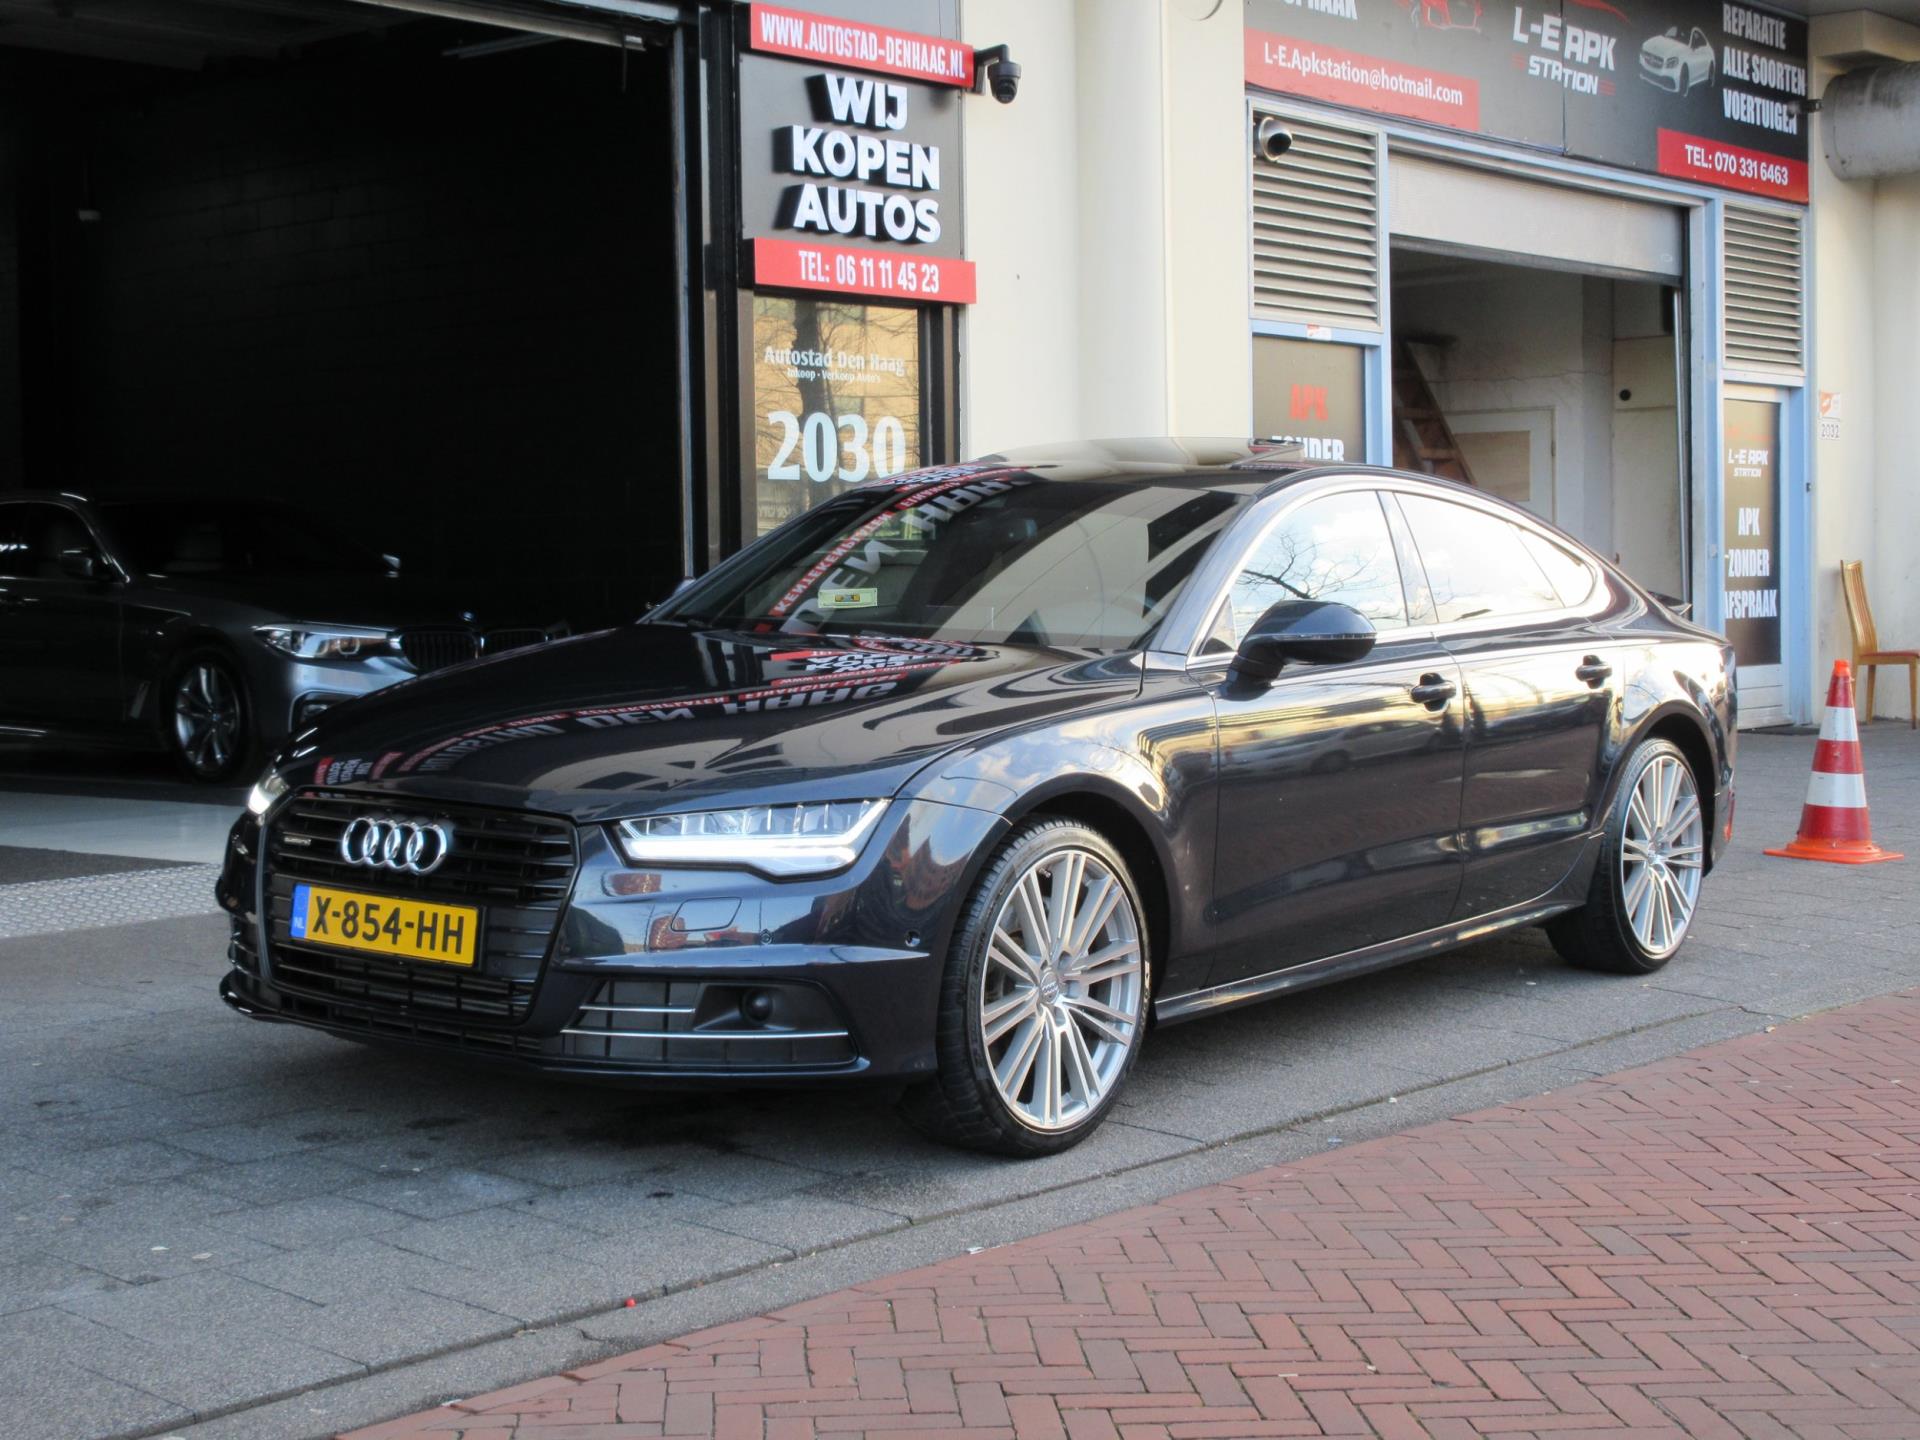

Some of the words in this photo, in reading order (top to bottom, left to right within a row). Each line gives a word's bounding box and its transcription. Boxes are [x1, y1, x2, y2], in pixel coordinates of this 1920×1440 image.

[761, 12, 966, 79] WWW.AUTOSTAD-DENHAAG.NL
[1513, 6, 1561, 51] L-E
[1564, 24, 1616, 71] APK
[1723, 4, 1786, 50] REPARATIE
[1264, 42, 1463, 105] L-E.Apkstation@hotmail.com
[1528, 54, 1598, 95] STATION
[1723, 46, 1750, 81] ALLE
[1752, 54, 1806, 97] SOORTEN
[824, 73, 908, 131] WIJ
[792, 125, 940, 190] KOPEN
[1685, 144, 1713, 169] TEL:
[1714, 155, 1737, 175] 070
[1739, 158, 1758, 180] 331
[1759, 162, 1789, 186] 6463
[793, 183, 942, 243] AUTOS
[798, 250, 830, 283] TEL:
[836, 255, 856, 285] 06
[860, 257, 875, 288] 11
[878, 259, 893, 289] 11
[897, 261, 917, 292] 45
[921, 264, 940, 294] 23
[764, 346, 832, 368] Autostad
[837, 351, 865, 370] Den
[870, 353, 906, 377] Haag
[767, 410, 907, 483] 2030
[1748, 449, 1769, 465] APK
[1738, 507, 1760, 536] APK
[1728, 549, 1770, 577] ZONDER
[312, 895, 465, 955] X-854-HH
